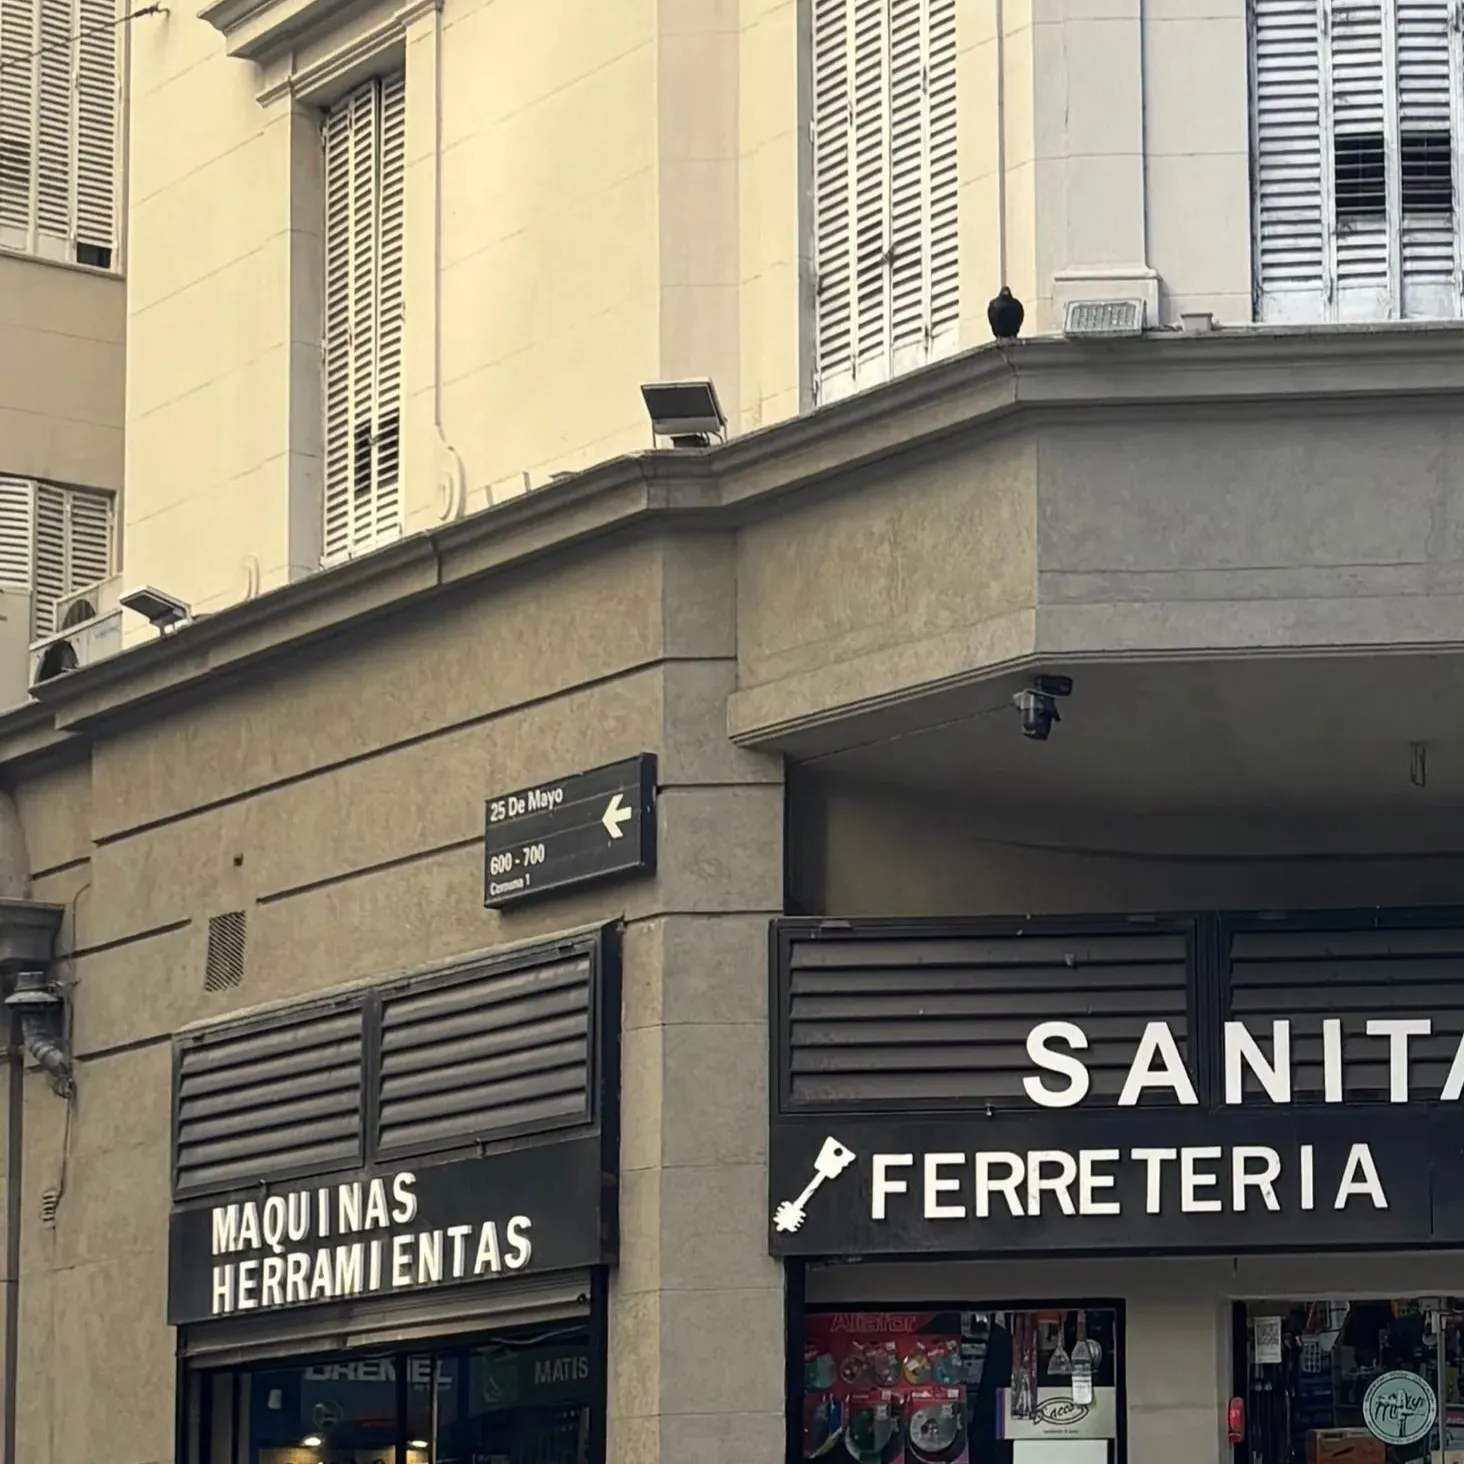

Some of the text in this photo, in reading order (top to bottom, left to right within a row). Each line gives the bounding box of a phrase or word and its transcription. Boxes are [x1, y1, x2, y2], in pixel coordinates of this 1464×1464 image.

[490, 788, 563, 822] 25 De Mayo
[490, 852, 513, 875] 600
[522, 843, 546, 867] 700
[490, 872, 531, 896] Comuna 1
[871, 1143, 1389, 1220] FERRETERIA
[212, 1171, 418, 1254] MAQUINAS
[212, 1215, 534, 1314] HERRAMIENTAS
